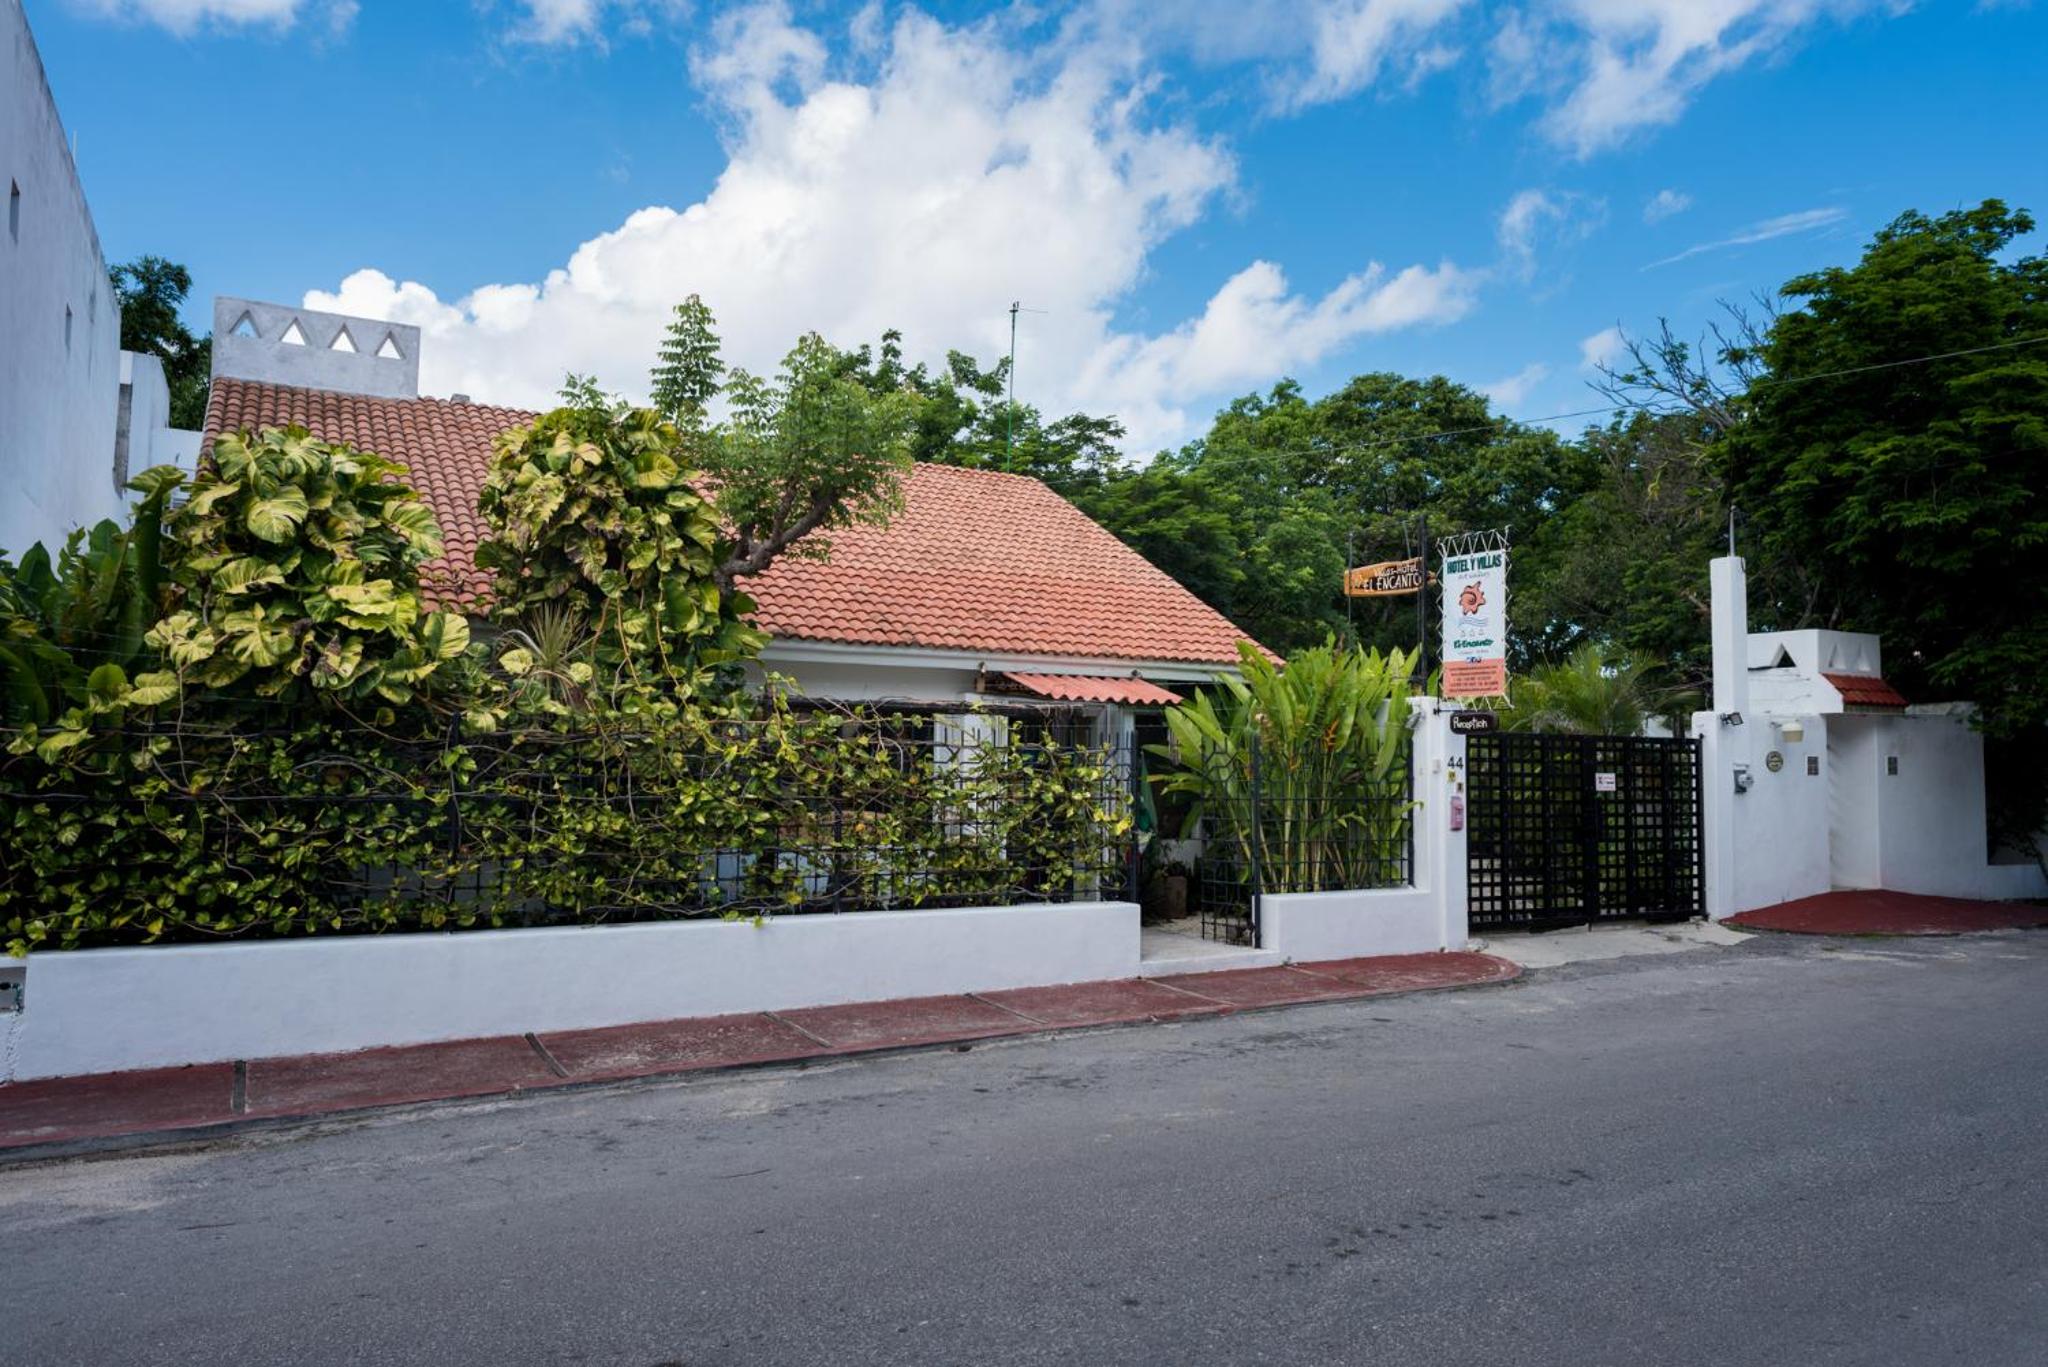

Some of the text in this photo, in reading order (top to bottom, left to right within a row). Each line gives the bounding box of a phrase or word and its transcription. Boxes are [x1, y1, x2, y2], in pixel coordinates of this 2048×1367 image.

[1447, 554, 1502, 574] HOTEL Y VILLAS
[1363, 571, 1421, 592] EL ENCANTO
[1447, 756, 1464, 769] 44
